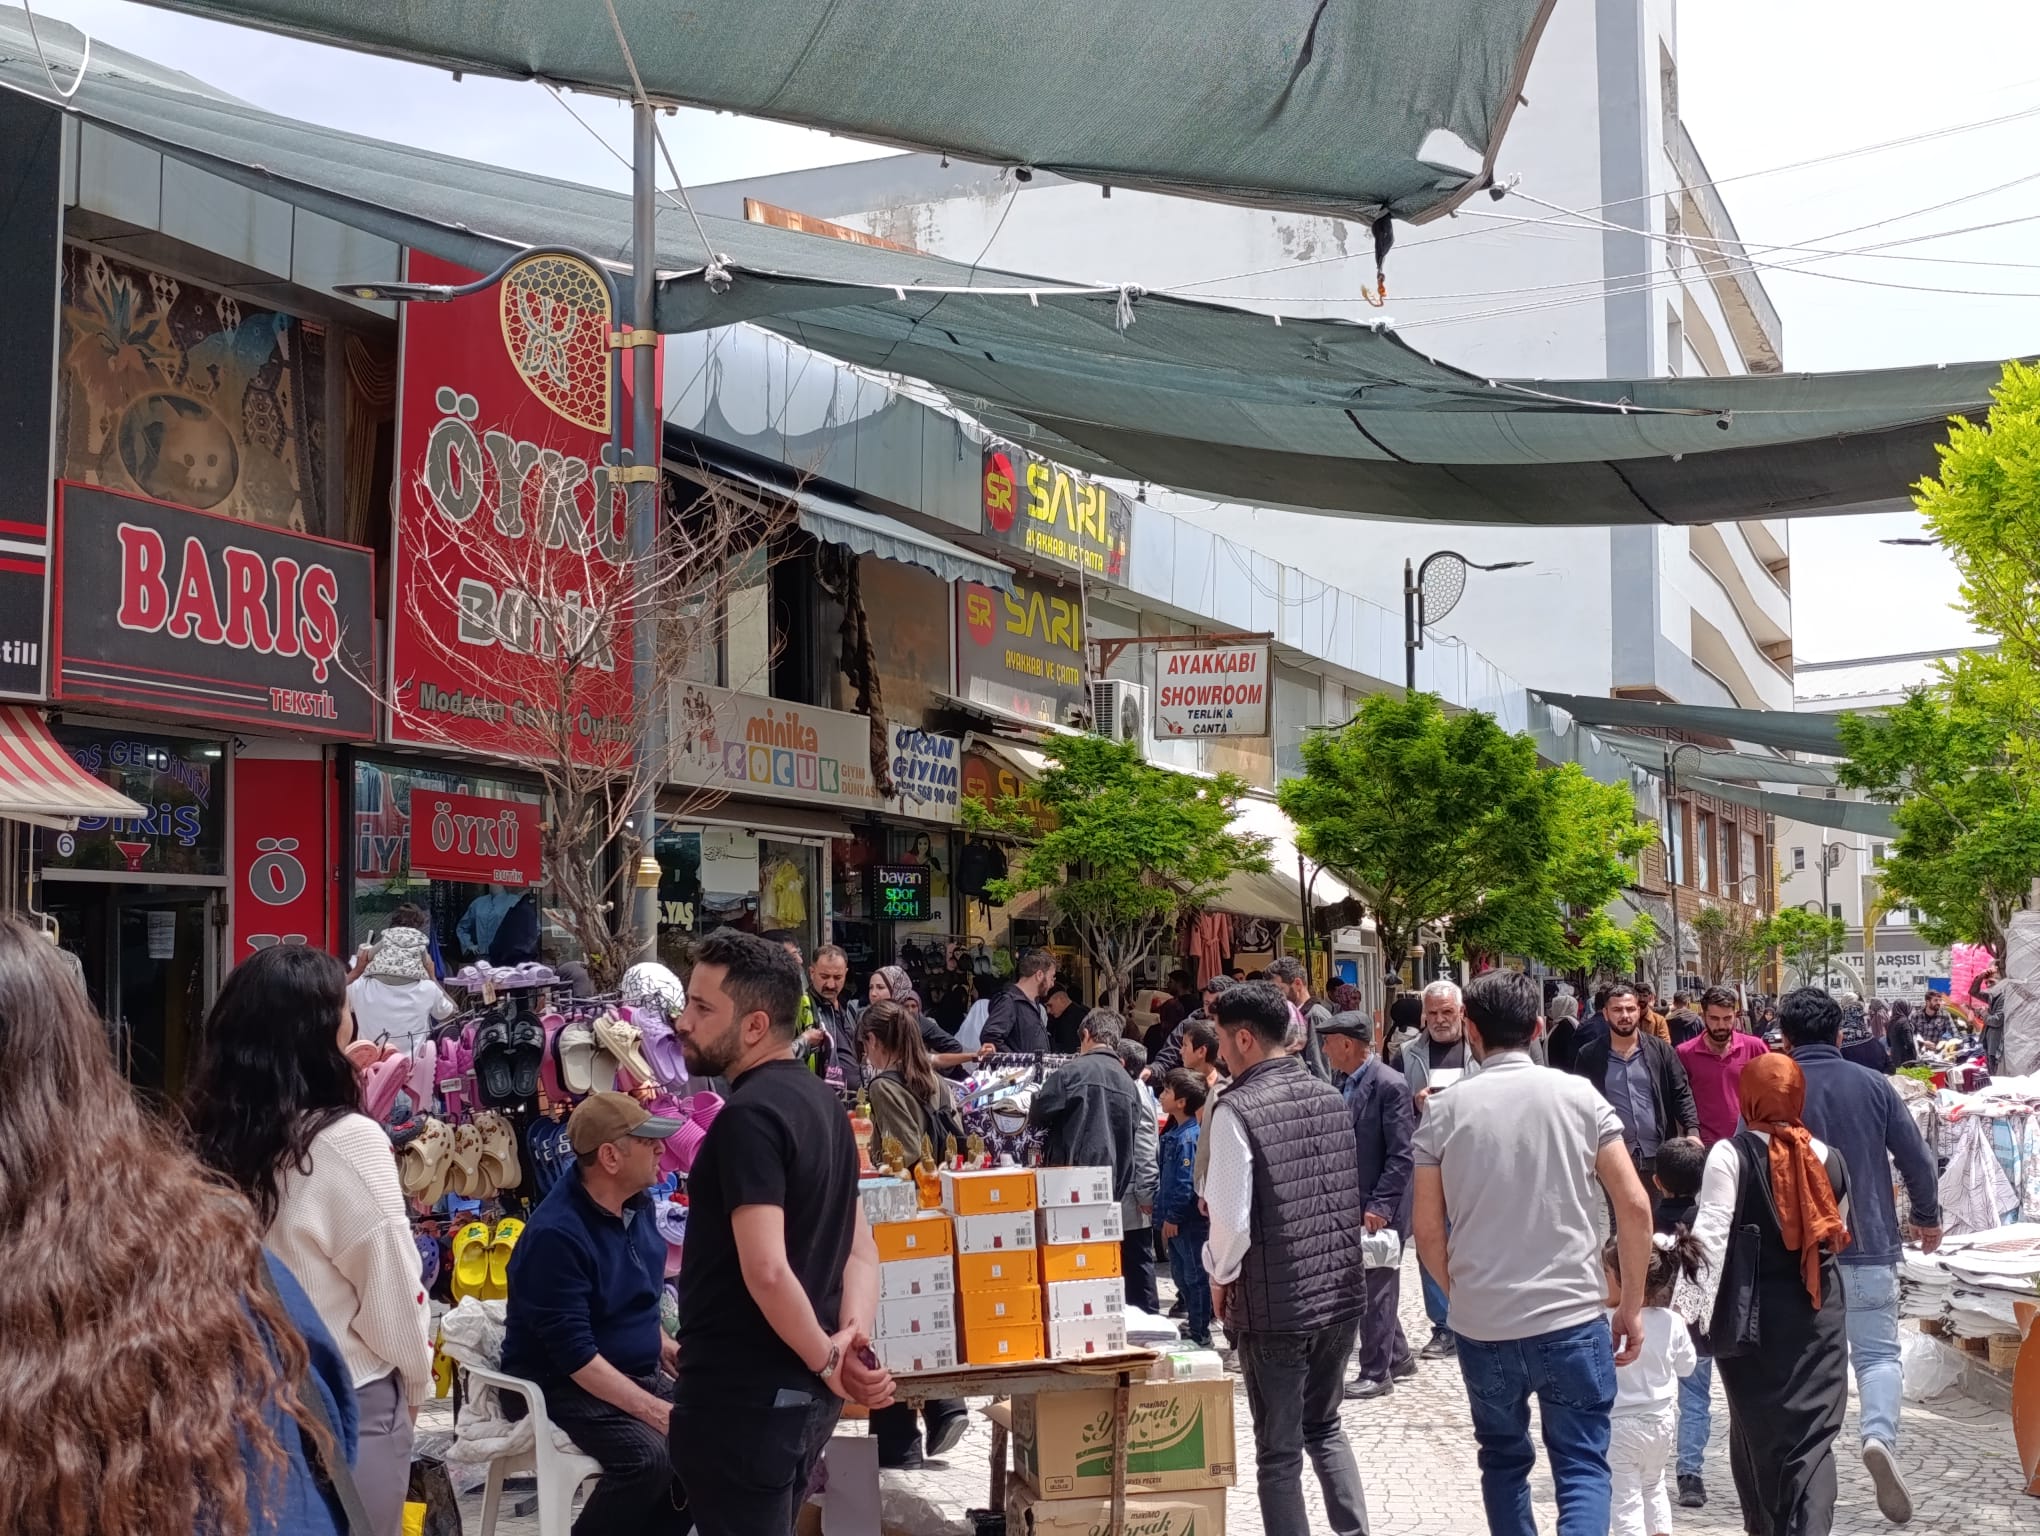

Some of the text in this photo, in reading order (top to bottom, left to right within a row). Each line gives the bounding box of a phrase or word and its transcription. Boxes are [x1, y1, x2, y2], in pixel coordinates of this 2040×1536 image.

[1027, 463, 1105, 543] SARI
[1026, 528, 1066, 558] AYAKKABI
[117, 522, 339, 683] BARIŞ
[1004, 586, 1079, 651] SARI
[0, 640, 37, 666] till
[1005, 649, 1079, 687] AYAKKABI VE ÇANTA
[1167, 652, 1257, 675] AYAKKABI
[269, 686, 338, 719] TEKSTİL
[1160, 684, 1263, 707] SHOWROOM
[1187, 707, 1233, 719] TERLİK &
[746, 707, 819, 754] minika
[892, 753, 958, 787] GİYİM
[432, 801, 519, 859] ÖYKÜ
[880, 869, 921, 887] bayan
[885, 887, 916, 901] spor
[1839, 955, 1864, 967] LTI
